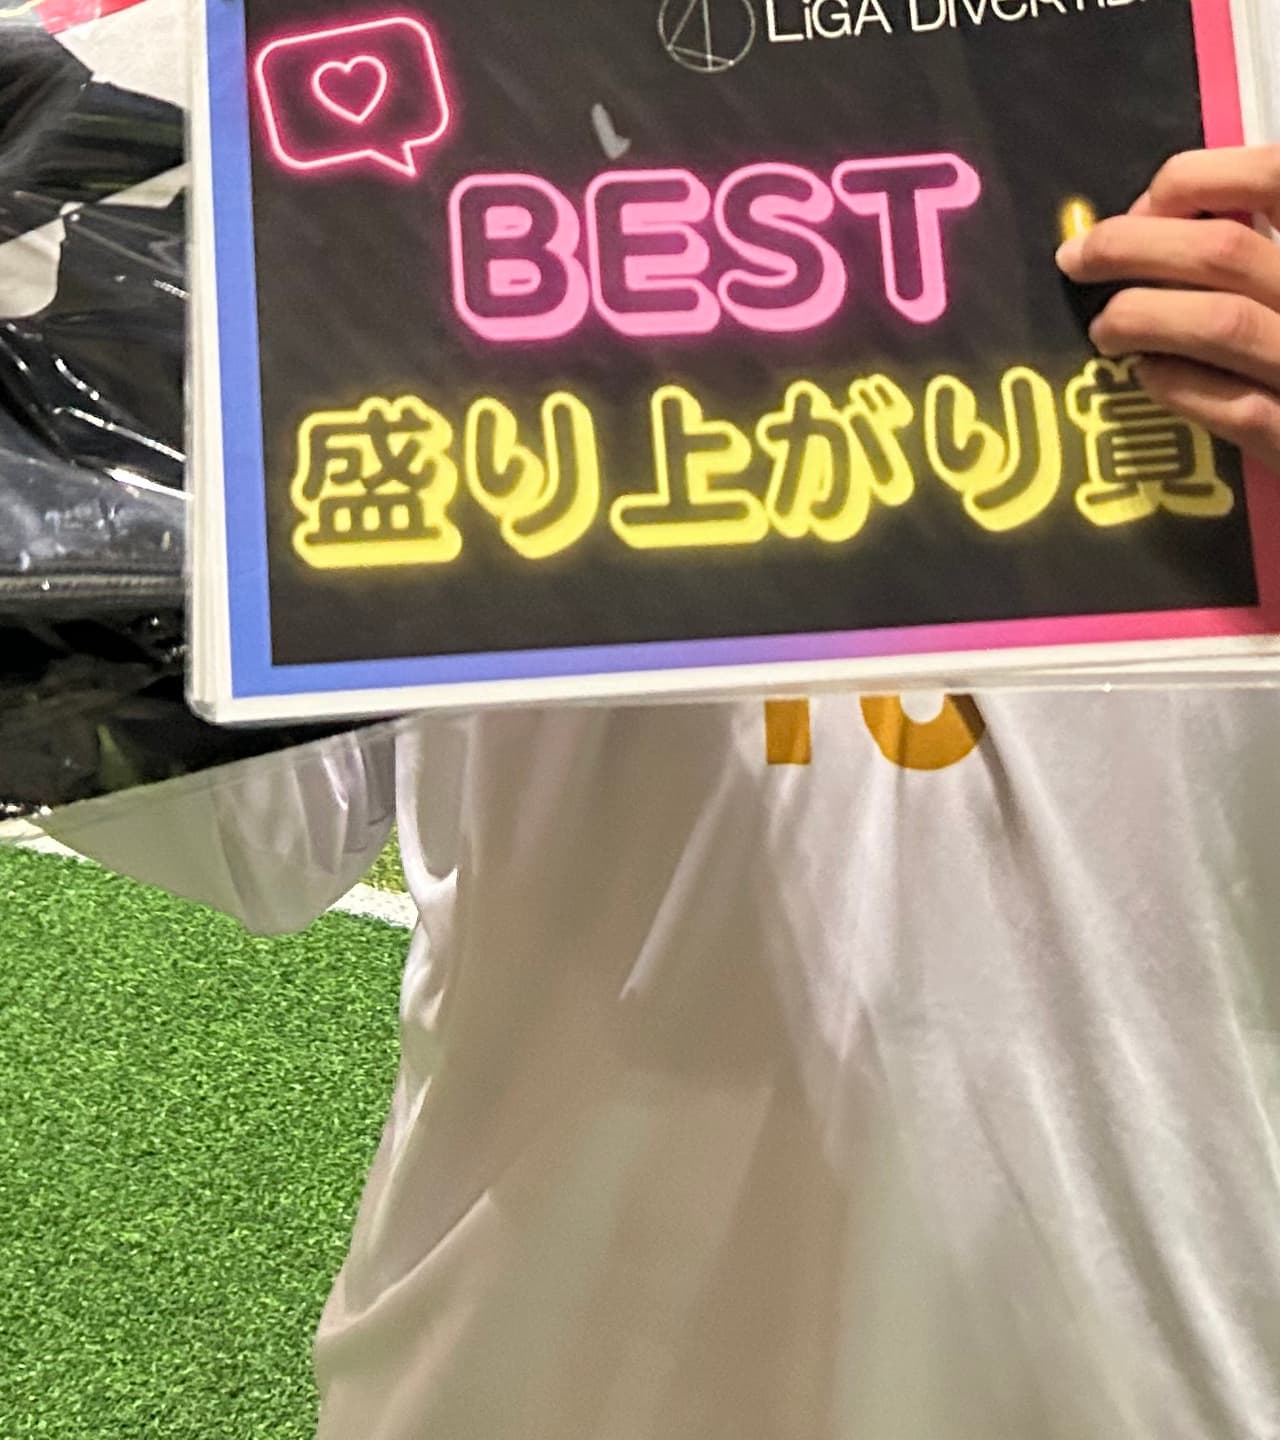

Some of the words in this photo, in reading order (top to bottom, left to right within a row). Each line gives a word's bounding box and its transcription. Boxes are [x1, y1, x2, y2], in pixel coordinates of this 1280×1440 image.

[448, 151, 982, 342] BEST
[292, 359, 1235, 568] 盛り上がり賞
